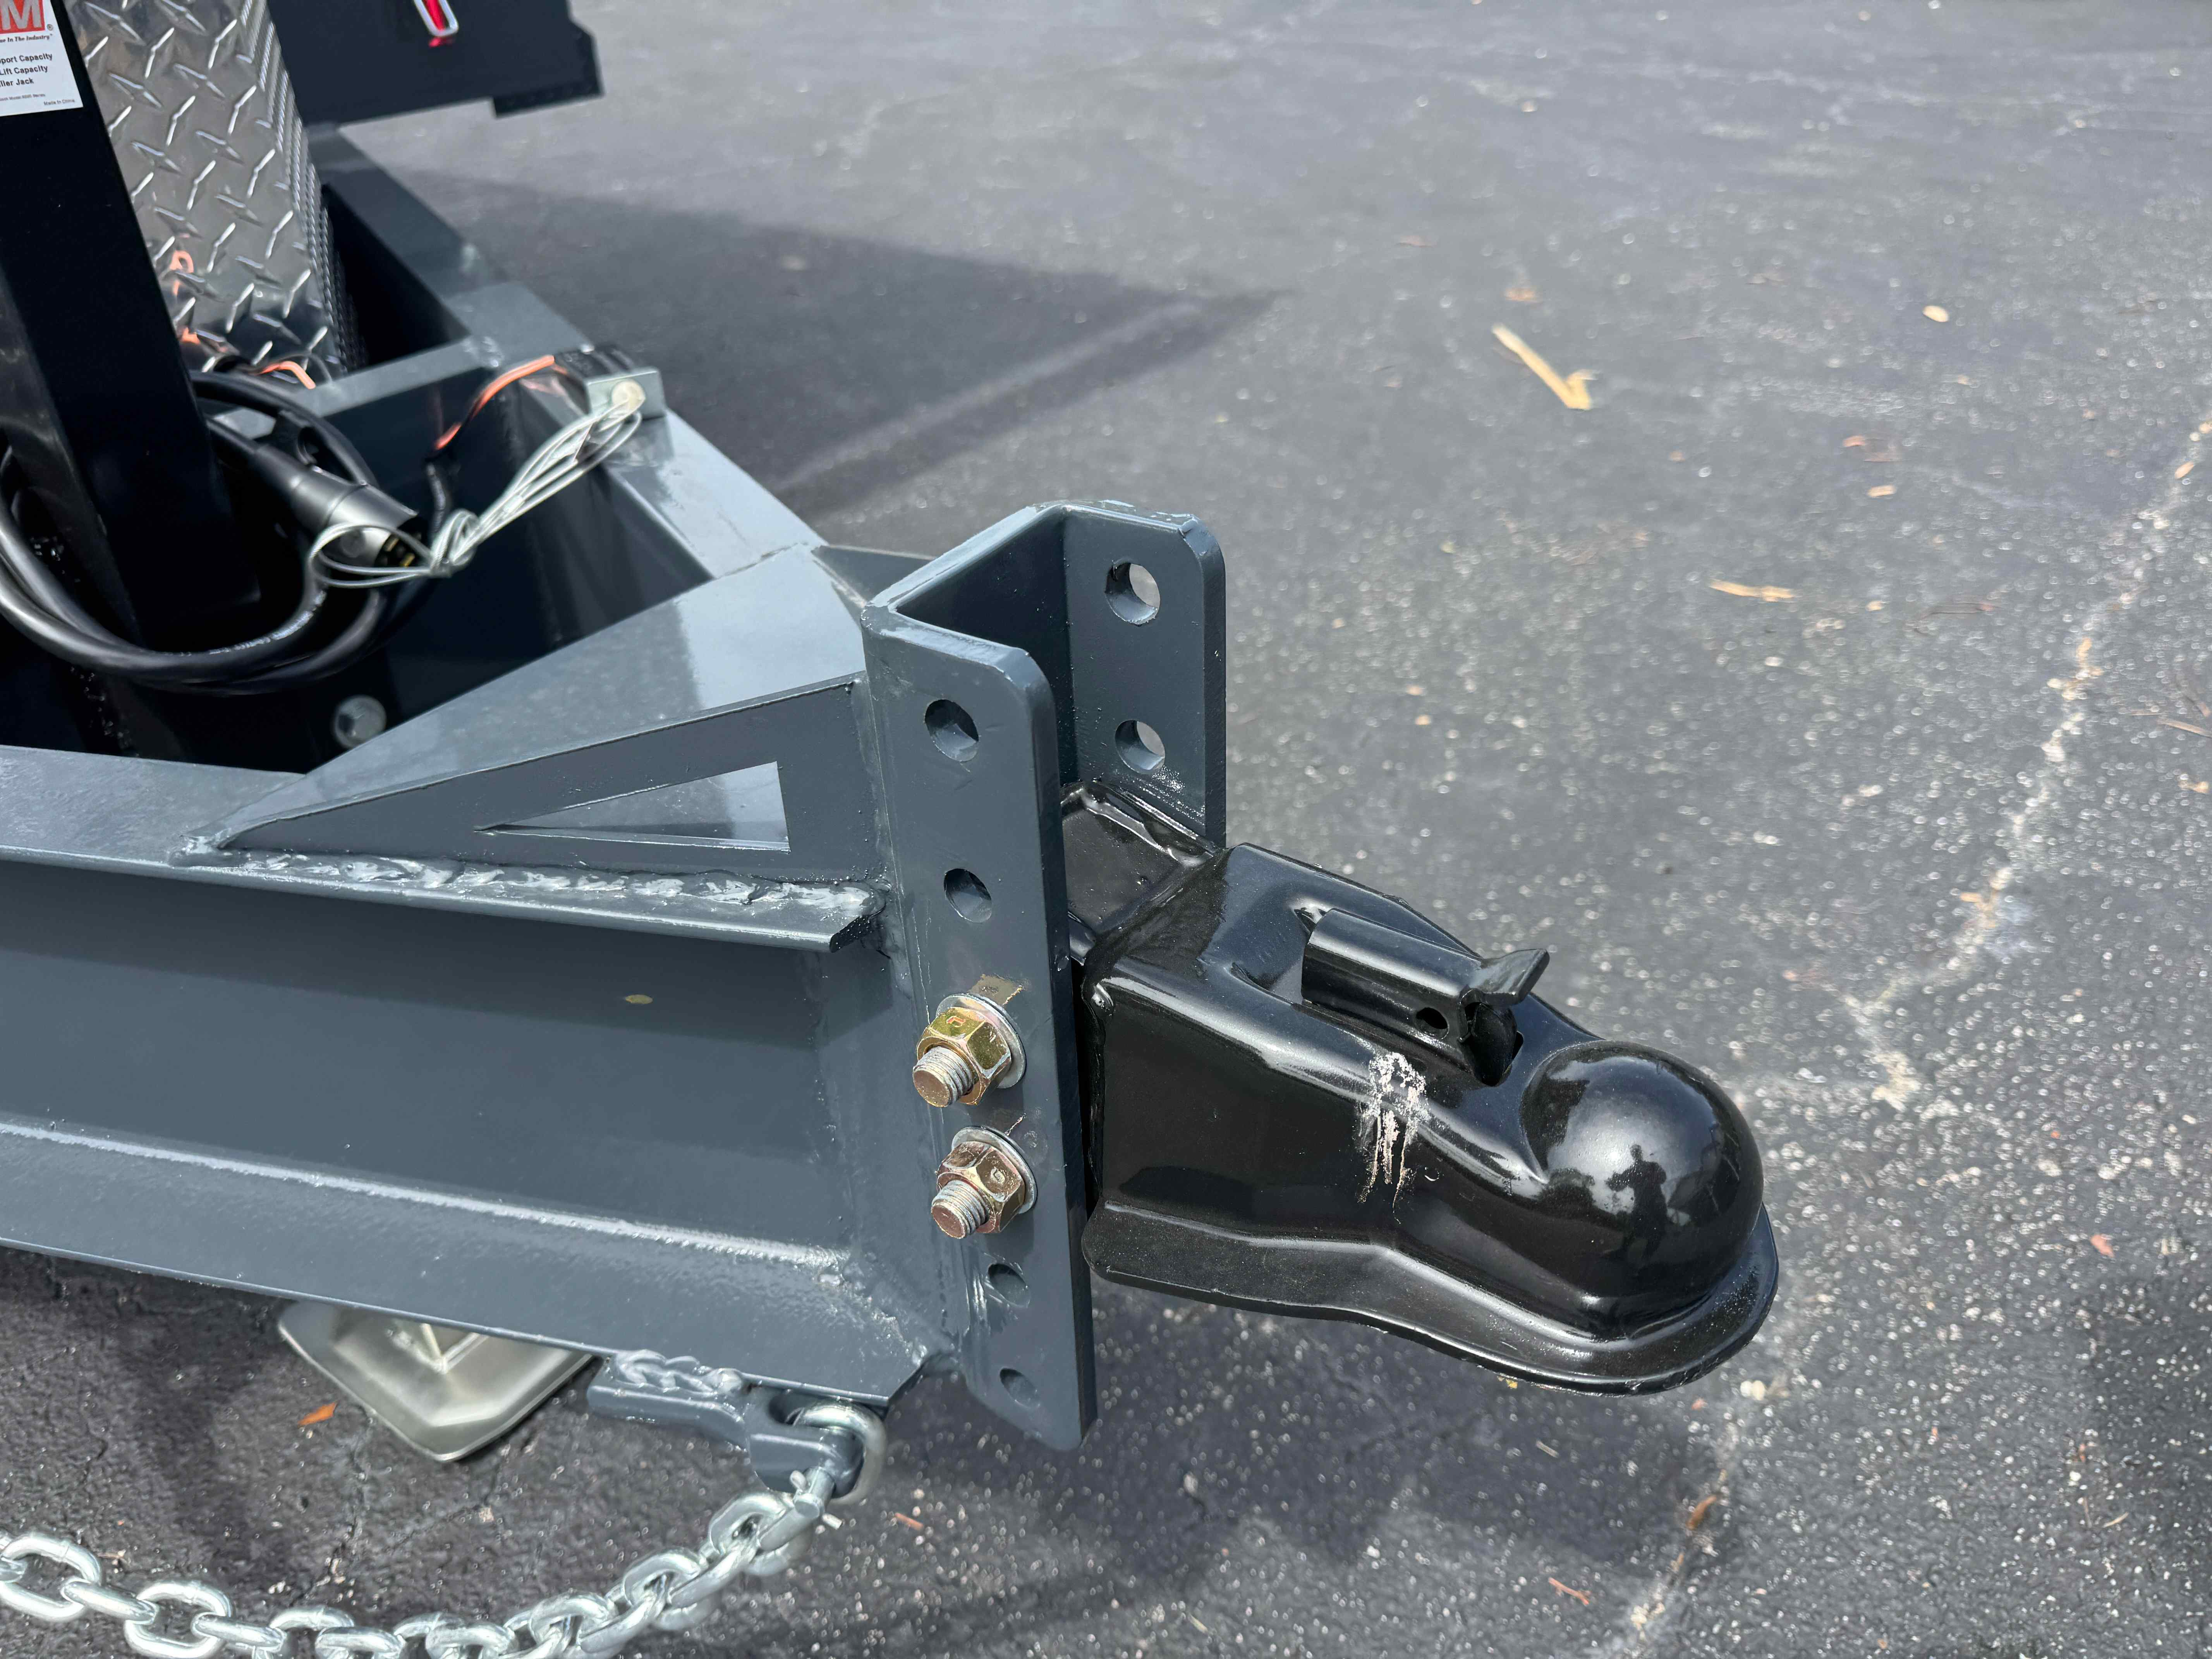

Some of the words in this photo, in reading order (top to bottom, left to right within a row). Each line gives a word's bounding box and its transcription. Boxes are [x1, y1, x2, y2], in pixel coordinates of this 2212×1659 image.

[0, 56, 17, 65] port
[19, 53, 53, 62] Capacity
[14, 65, 48, 74] Capacity
